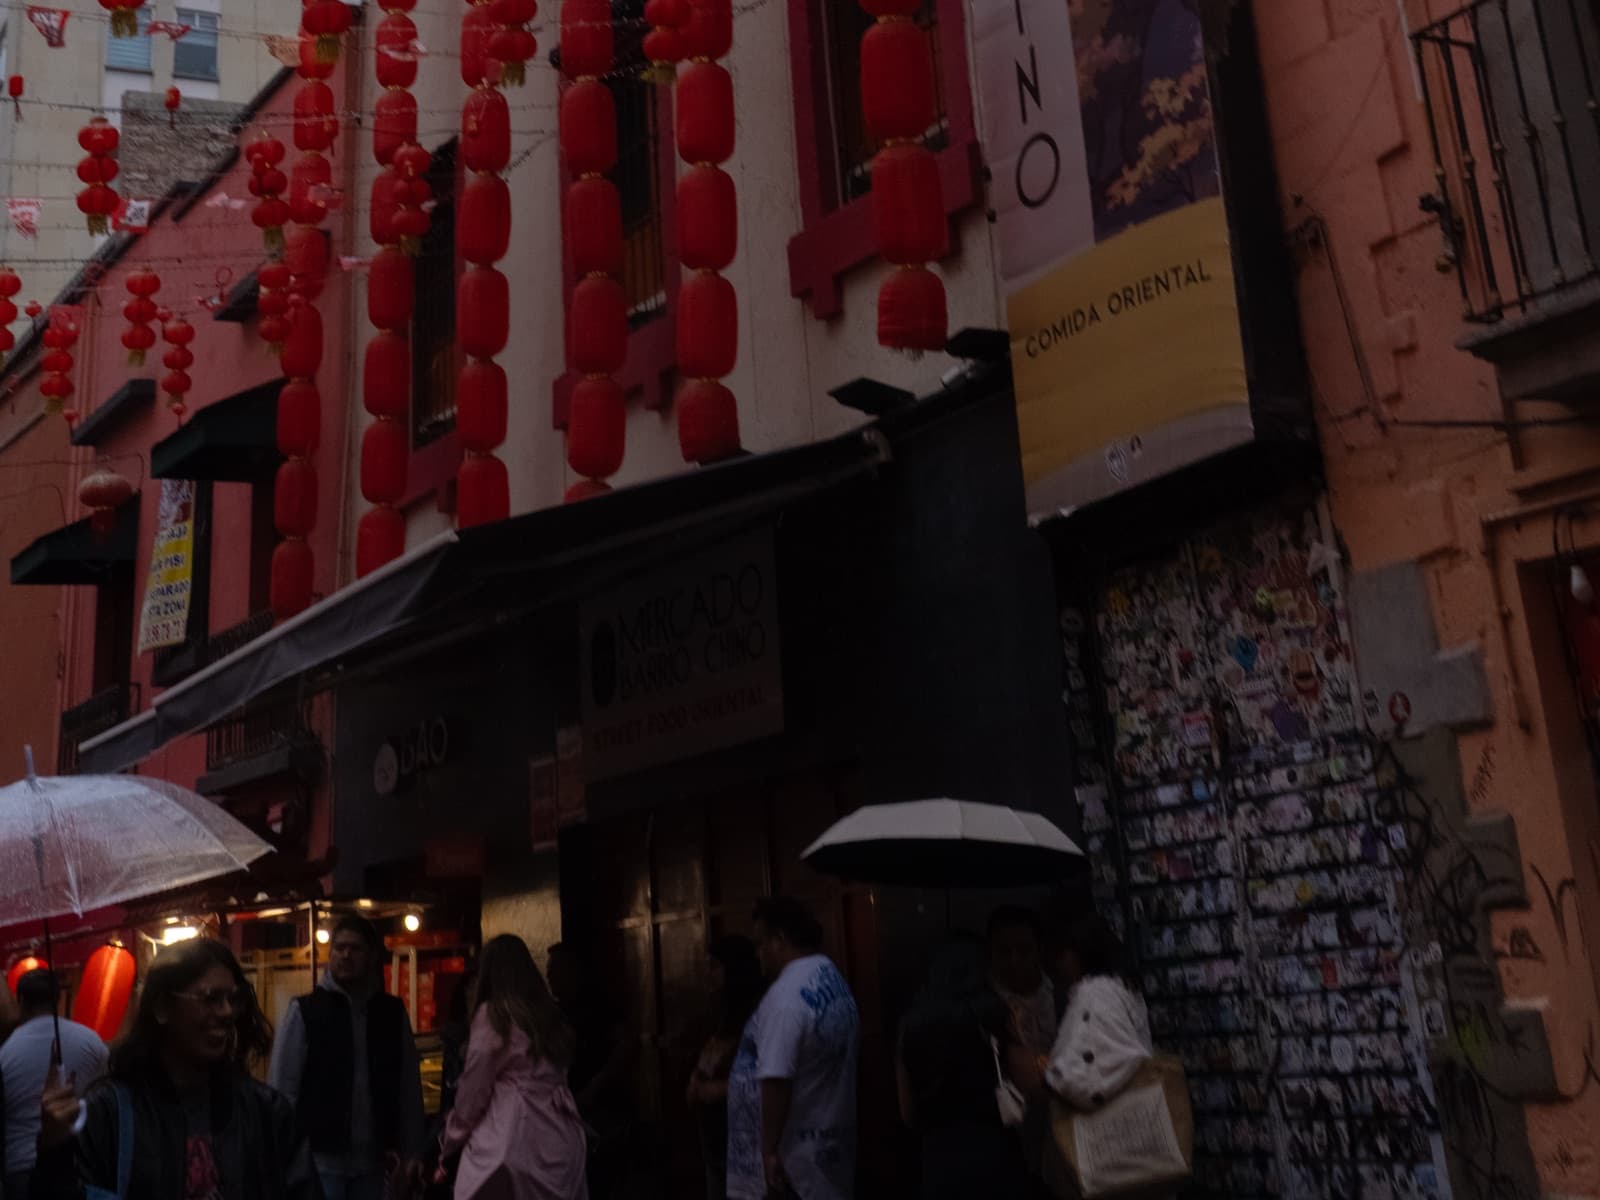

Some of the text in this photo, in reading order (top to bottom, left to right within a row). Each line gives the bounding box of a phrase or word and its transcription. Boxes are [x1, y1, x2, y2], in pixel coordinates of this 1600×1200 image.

[1025, 259, 1211, 359] COMIDA ORIENTAL
[618, 562, 764, 654] MERCADO
[620, 620, 766, 701] BARRIO CHINO
[647, 704, 689, 736] FOOD
[691, 686, 767, 724] ORIENTAL
